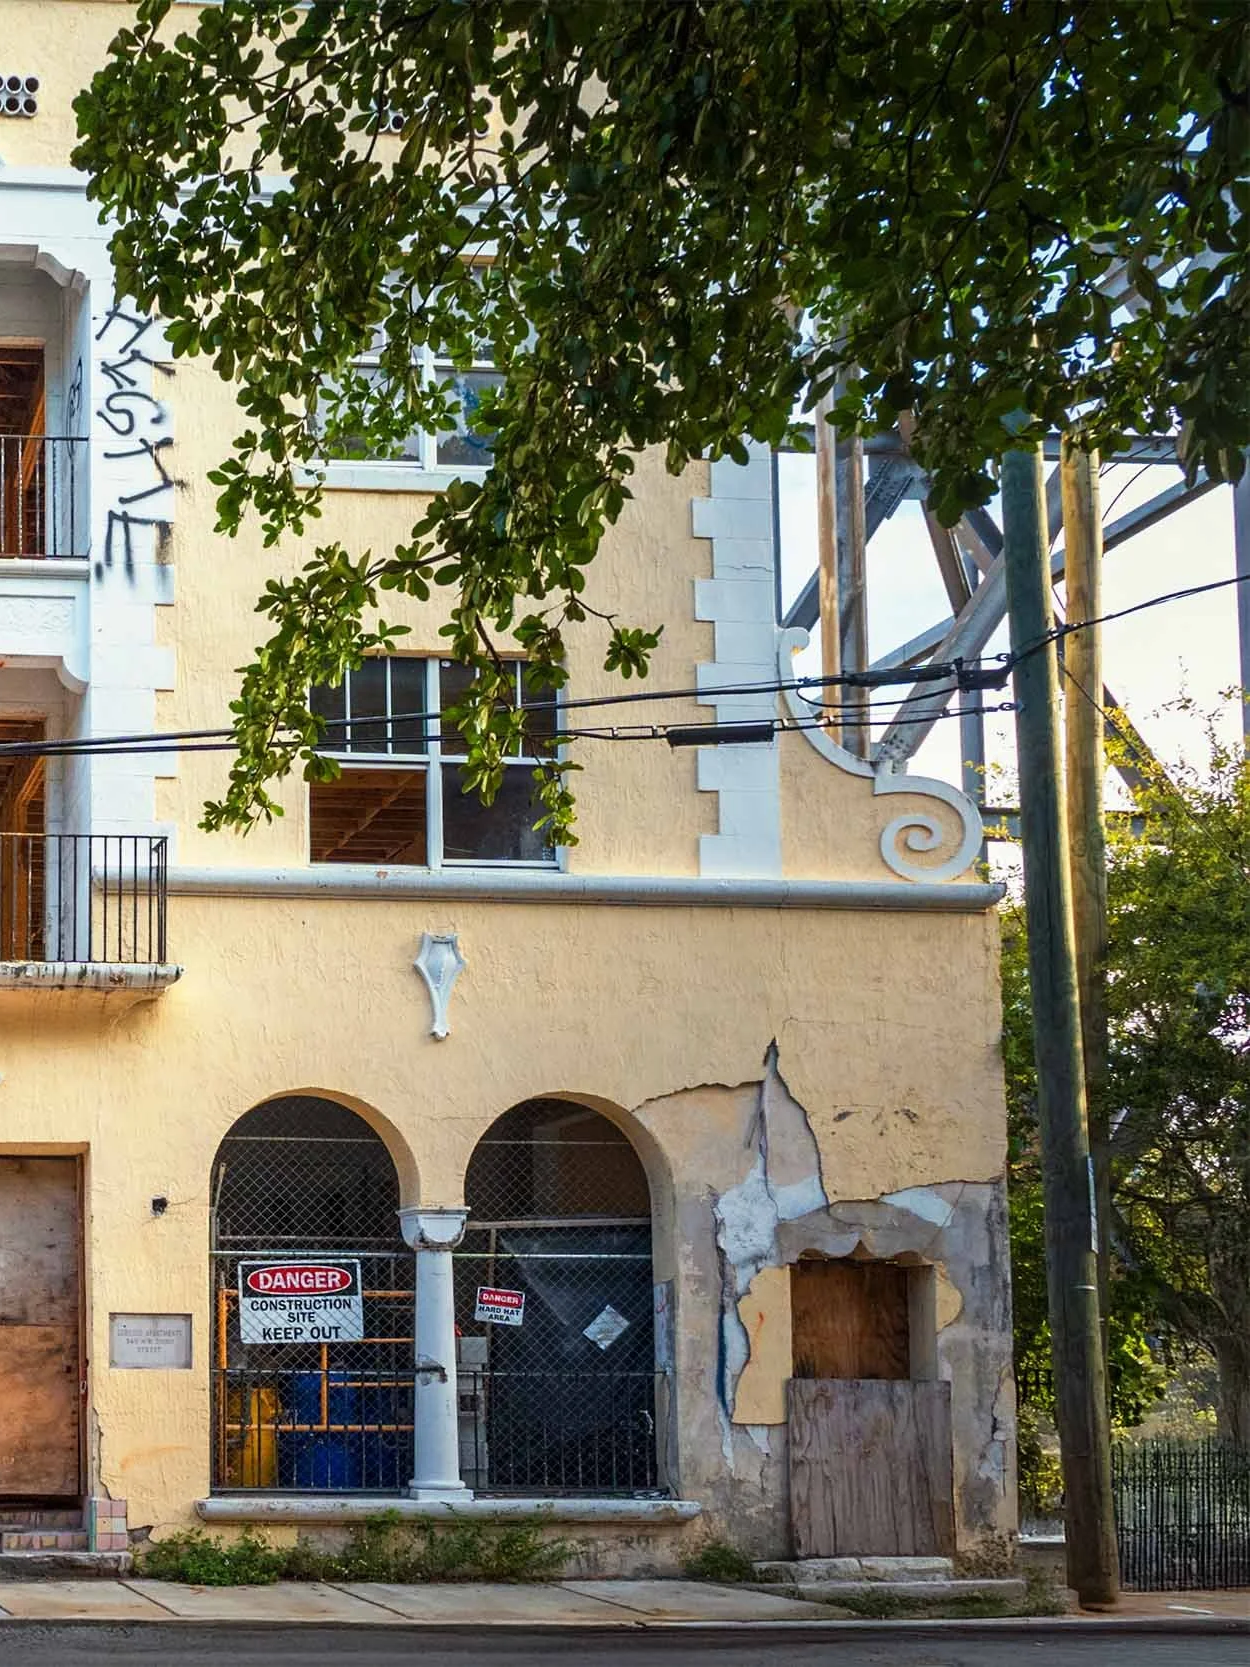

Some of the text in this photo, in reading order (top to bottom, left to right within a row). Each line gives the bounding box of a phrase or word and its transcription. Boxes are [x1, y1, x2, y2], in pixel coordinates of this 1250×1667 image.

[259, 1271, 341, 1289] DANGER
[251, 1298, 351, 1311] CONSTRUCTION
[482, 1293, 518, 1304] DANGER
[287, 1312, 316, 1323] SITE
[262, 1326, 341, 1340] KEEP OUT
